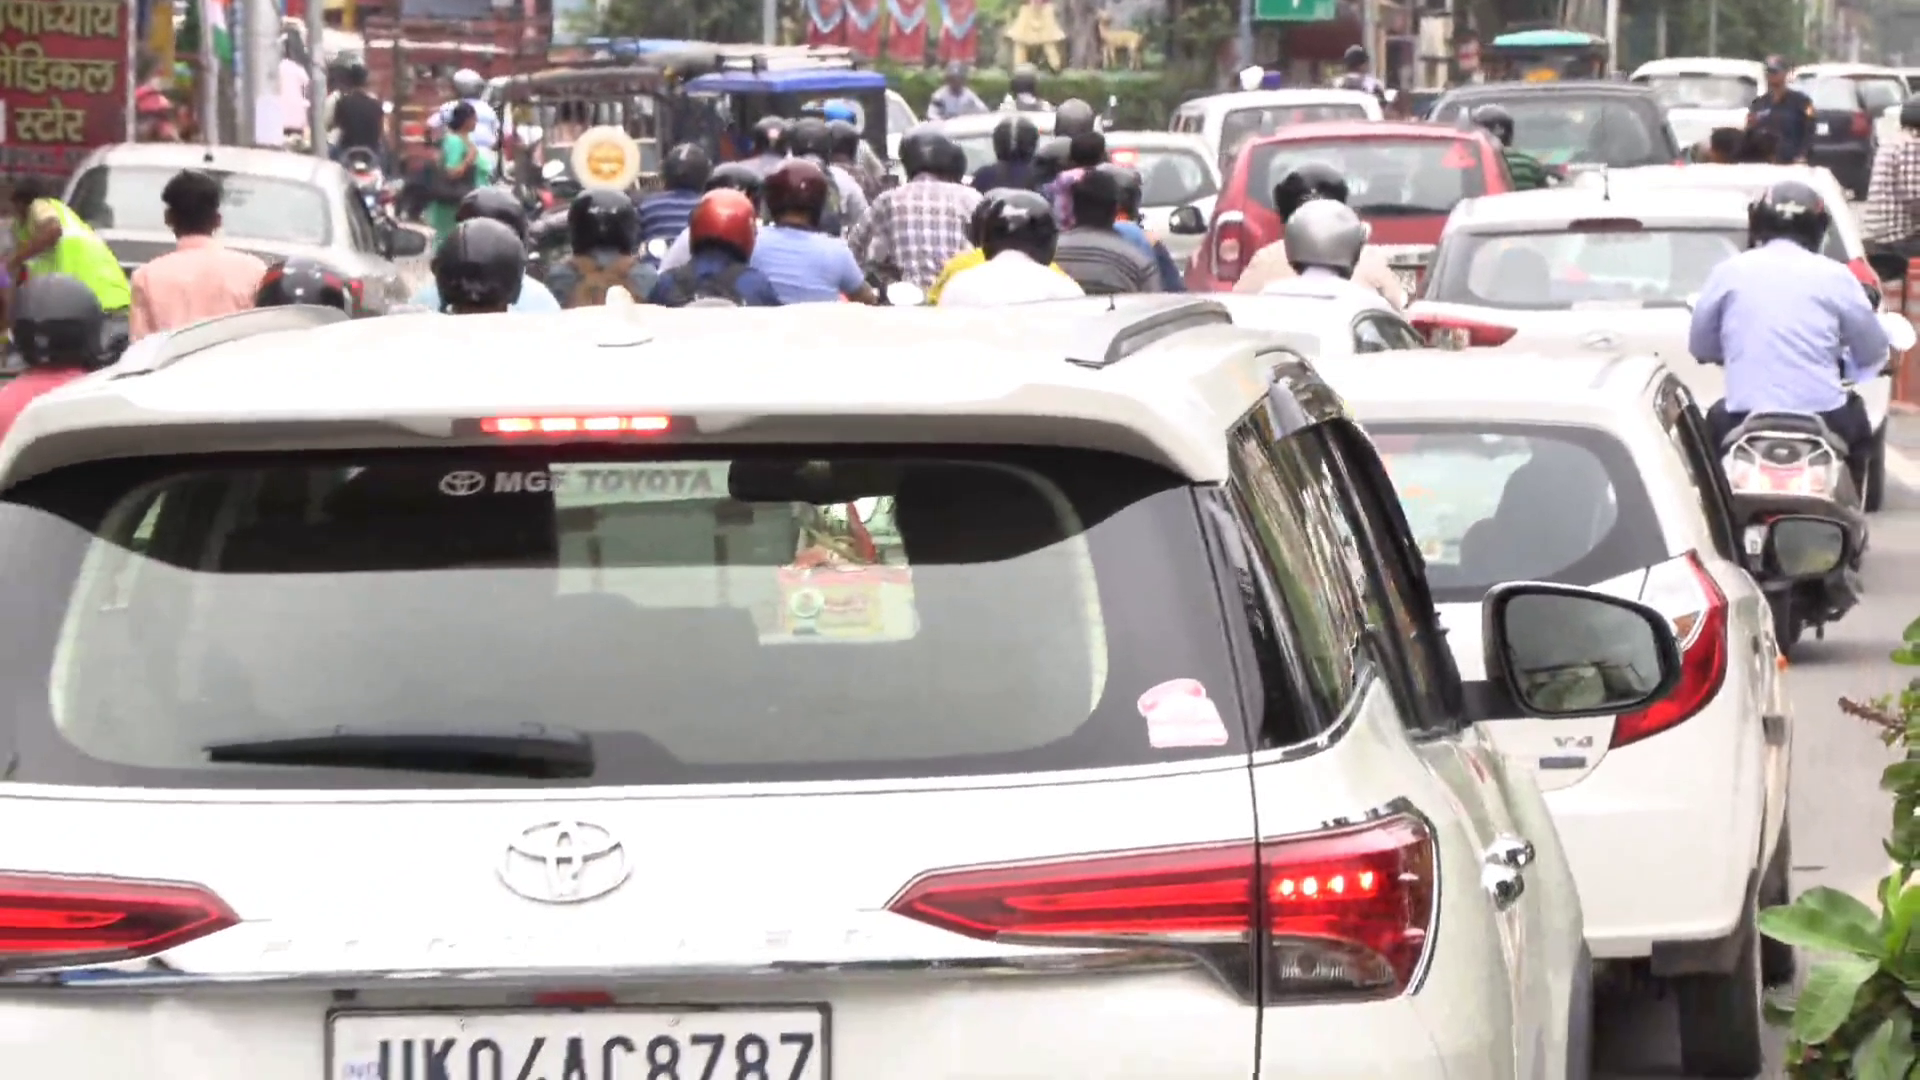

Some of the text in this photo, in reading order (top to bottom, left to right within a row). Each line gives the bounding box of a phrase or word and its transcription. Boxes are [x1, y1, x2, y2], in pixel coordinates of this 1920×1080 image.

[0, 0, 118, 37] पाध्याय
[15, 97, 85, 142] स्टोर
[579, 469, 713, 494] TOYOTA
